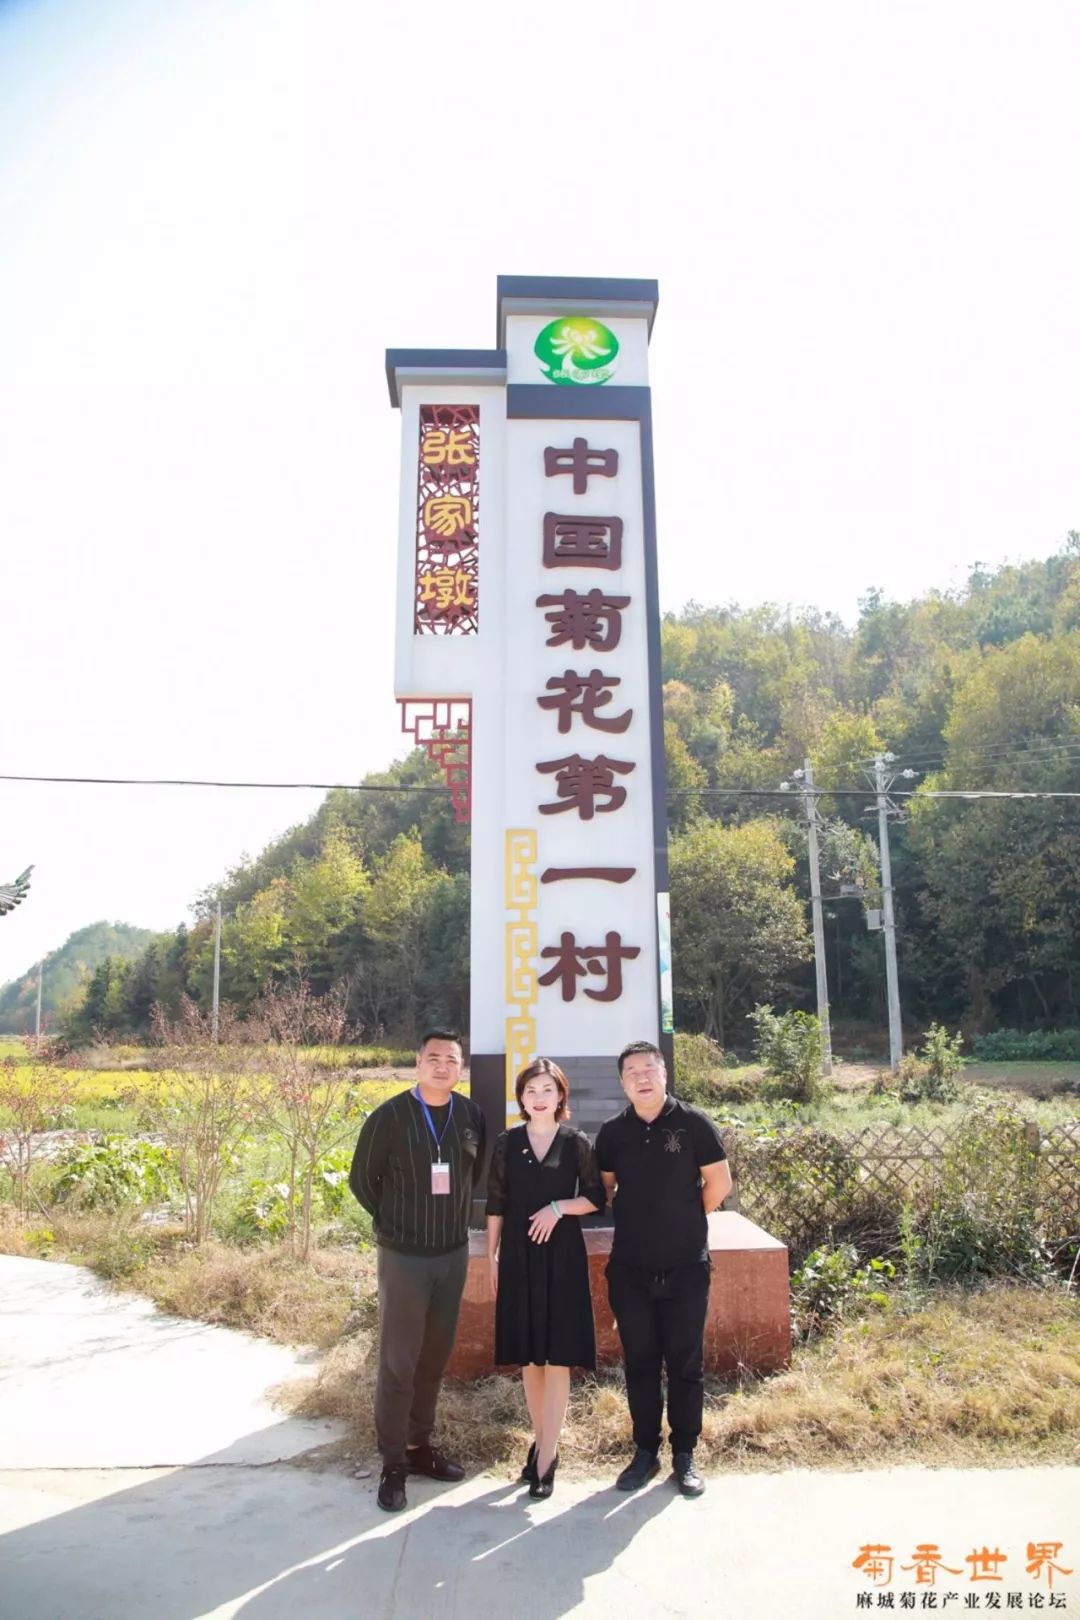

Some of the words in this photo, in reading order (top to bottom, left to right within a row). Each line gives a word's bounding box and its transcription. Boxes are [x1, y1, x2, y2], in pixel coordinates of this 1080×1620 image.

[419, 430, 476, 609] 张家墩
[535, 437, 641, 1002] 中国菊花第一村
